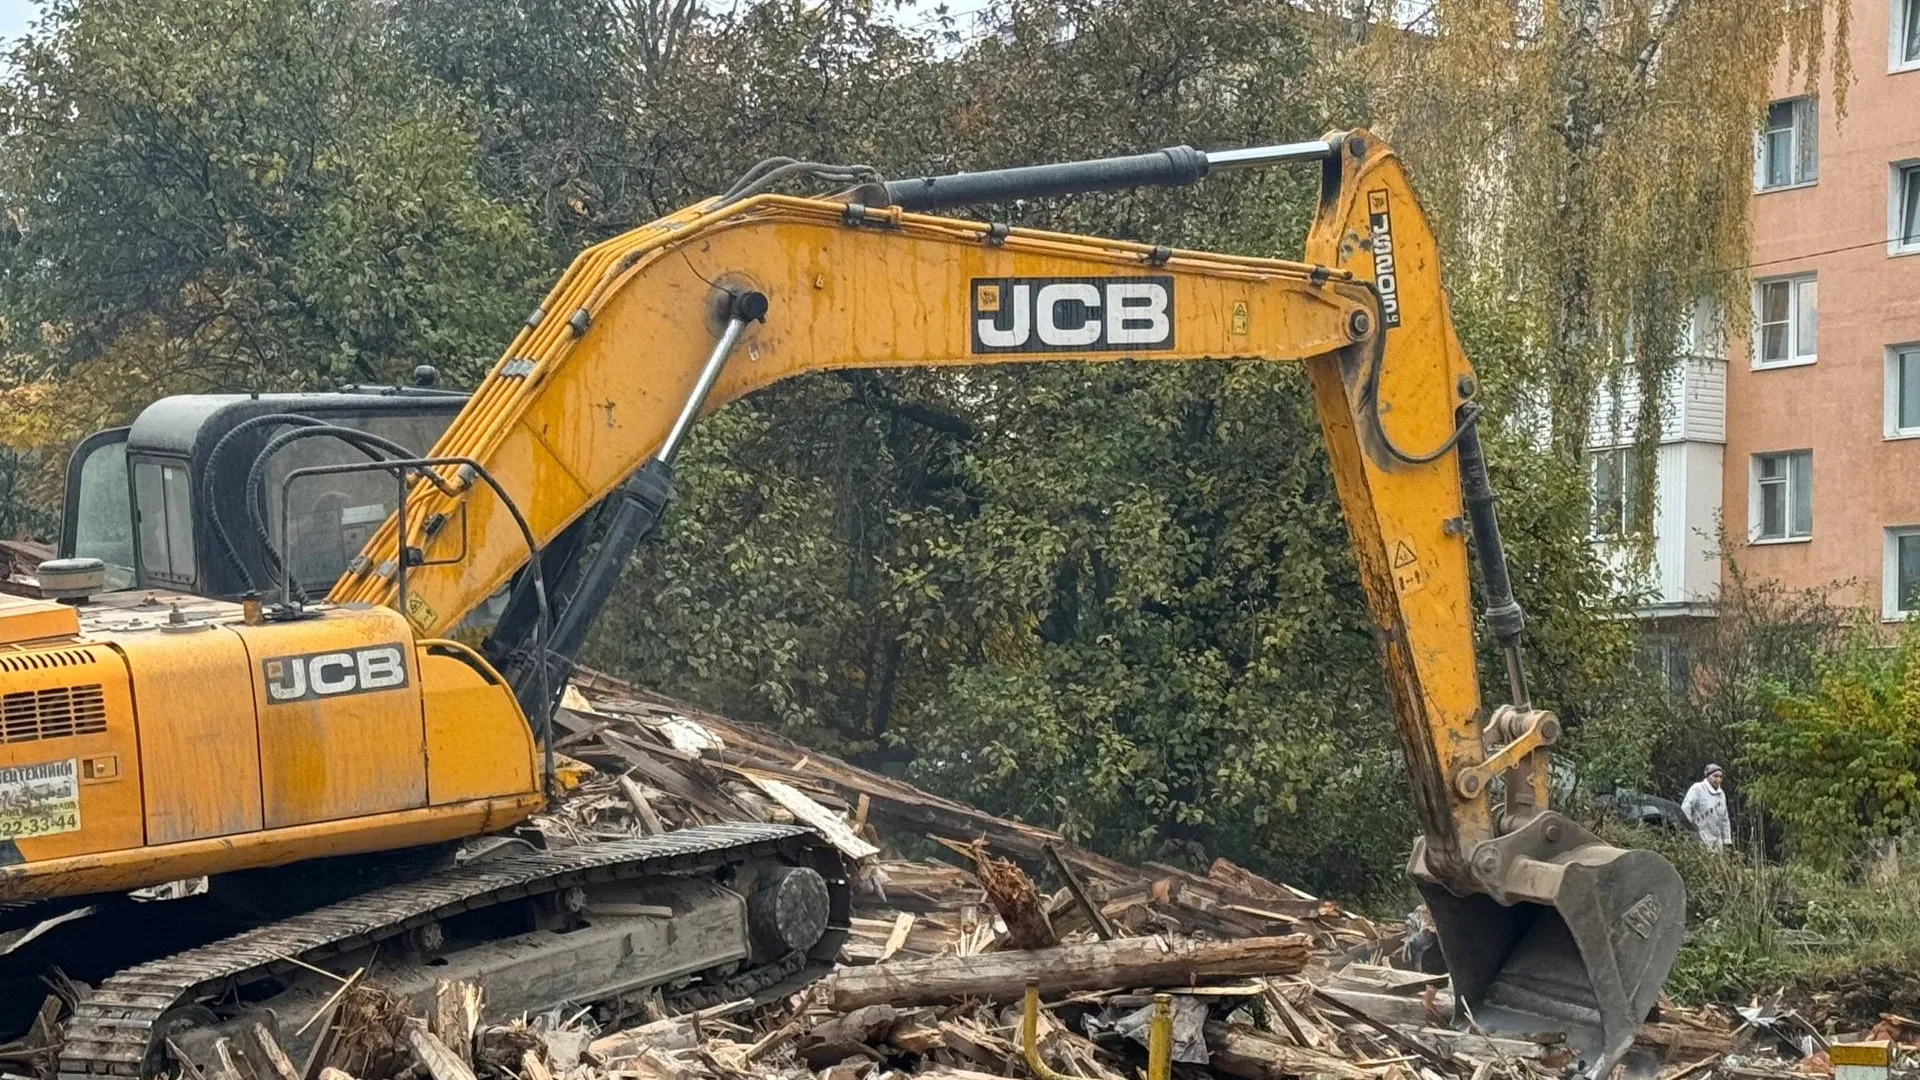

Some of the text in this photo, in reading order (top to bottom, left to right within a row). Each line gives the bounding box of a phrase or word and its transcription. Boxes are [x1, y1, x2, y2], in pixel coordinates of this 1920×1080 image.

[978, 283, 1170, 347] JCB
[267, 647, 405, 700] JCB
[0, 762, 73, 784] ЕЦТЕХНИКИ
[0, 813, 77, 837] 22-33-44
